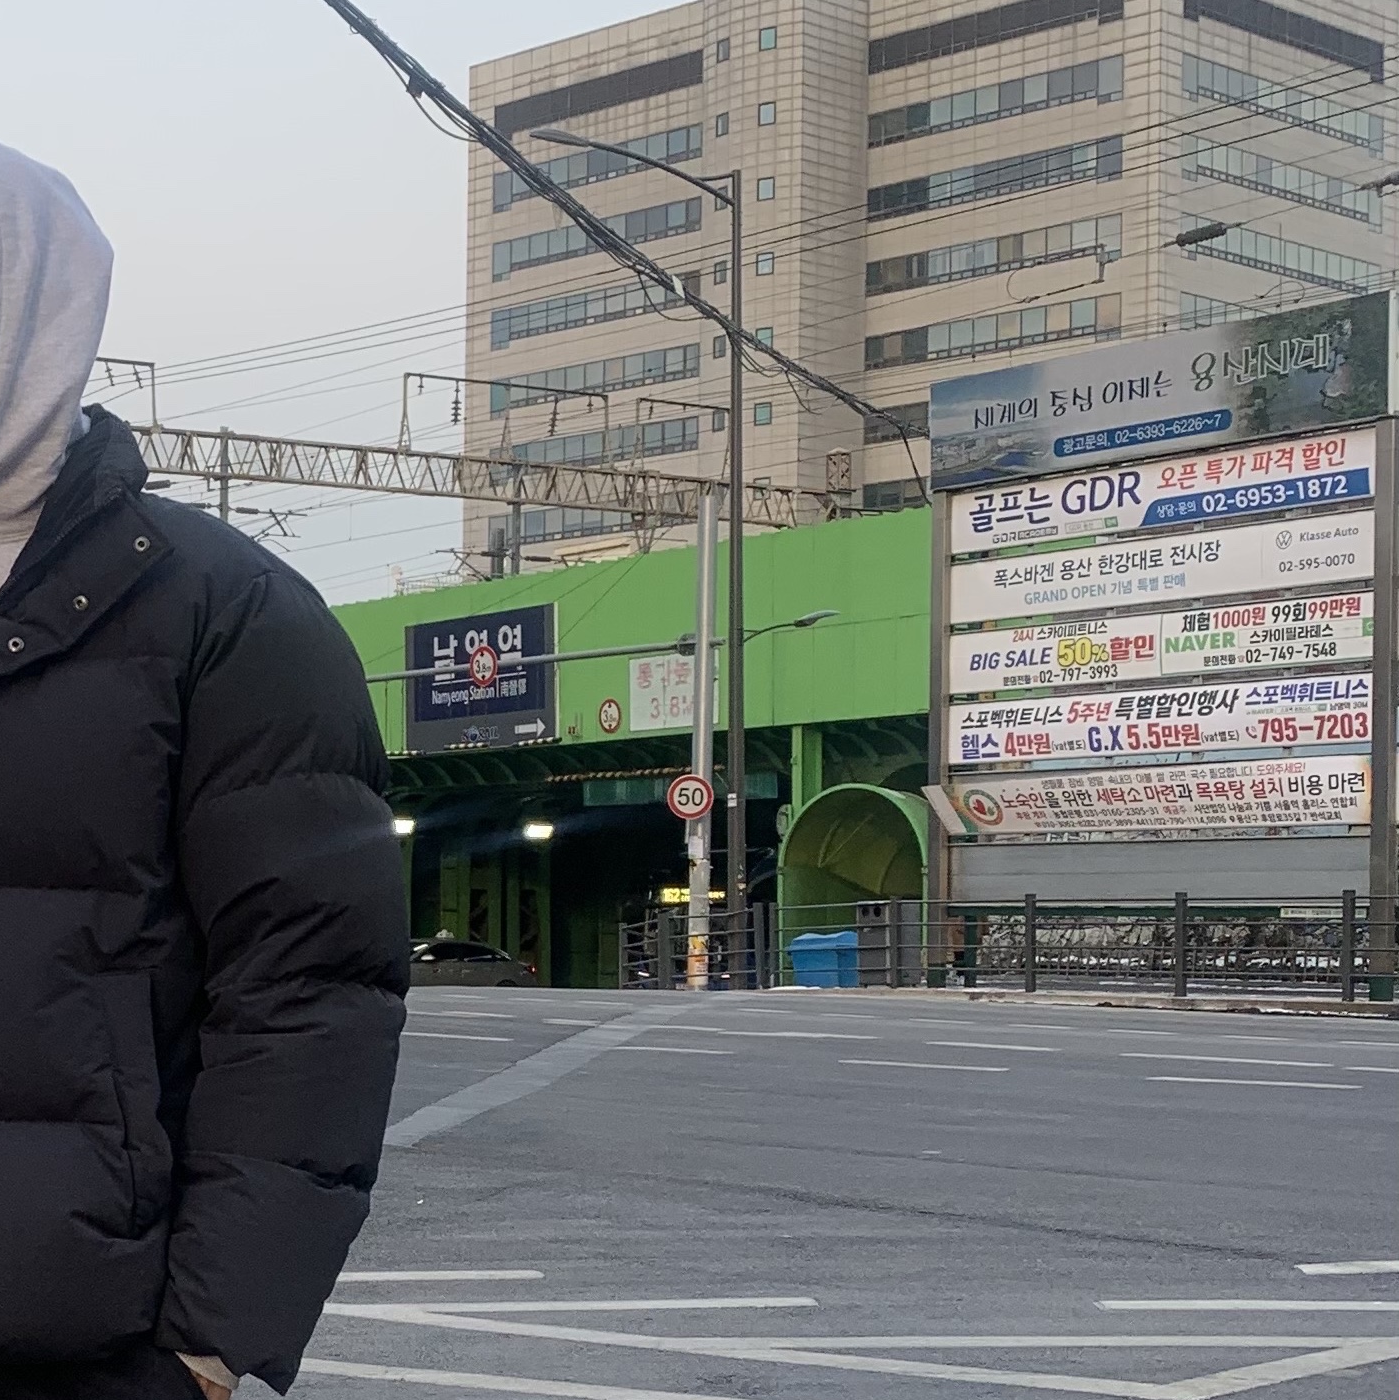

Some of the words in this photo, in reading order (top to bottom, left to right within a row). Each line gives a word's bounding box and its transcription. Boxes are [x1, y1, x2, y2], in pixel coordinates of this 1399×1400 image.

[974, 397, 1038, 429] 세계의
[1050, 385, 1093, 417] 중심
[1102, 370, 1173, 403] 이제는
[1190, 334, 1330, 392] 용산시대
[1114, 414, 1223, 443] 02-6393-6226~7
[1156, 462, 1198, 490] 오픈
[1203, 456, 1246, 485] 특가
[1251, 447, 1294, 475] 파격
[1301, 438, 1347, 471] 할인
[968, 487, 1053, 533] 골프는
[1061, 471, 1142, 516] GDR
[1201, 475, 1349, 514] 02-6953-1872
[992, 531, 1017, 544] GDR
[1299, 529, 1332, 543] Klasse
[1333, 526, 1359, 538] Auto
[993, 562, 1055, 589] 폭스바겐
[1060, 557, 1092, 582] 용산
[1097, 548, 1164, 576] 한강대로
[1169, 539, 1222, 567] 전시장
[1279, 552, 1355, 573] 02-595-0070
[1024, 587, 1069, 606] GRAND
[1071, 584, 1107, 600] OPEN
[1110, 580, 1133, 596] 기념
[1137, 575, 1159, 592] 특별
[1162, 572, 1186, 589] 판매
[1012, 628, 1035, 643] 24시
[1164, 631, 1236, 654] NAVER
[1249, 623, 1334, 644] 스카이필라테스
[969, 652, 1000, 671] BIG
[1004, 646, 1053, 669] SALE
[1056, 636, 1110, 668] 50%
[1110, 634, 1156, 662] 할인
[1245, 641, 1337, 664] 02-749-7548
[1039, 663, 1119, 684] 02-797-3993
[431, 689, 470, 707] Namyeong
[469, 685, 495, 701] Station
[1244, 678, 1369, 706] 스포벡휘트니스
[960, 704, 1064, 730] 스포벡휘트니스
[1067, 700, 1114, 724] 5주년
[1257, 711, 1369, 743] 795-7203
[960, 732, 1001, 760] 헬스
[1087, 725, 1124, 753] G.X
[1256, 761, 1306, 776] 도와주세요!
[677, 787, 705, 807] 50
[1000, 788, 1062, 810] 노숙인을
[1062, 788, 1094, 807] 위한
[1095, 783, 1143, 806] 세탁소
[1143, 782, 1194, 804] 마련과
[1195, 778, 1246, 801] 목욕탕
[1249, 776, 1284, 799] 설치
[1288, 774, 1323, 796] 비용
[1328, 771, 1366, 794] 마련
